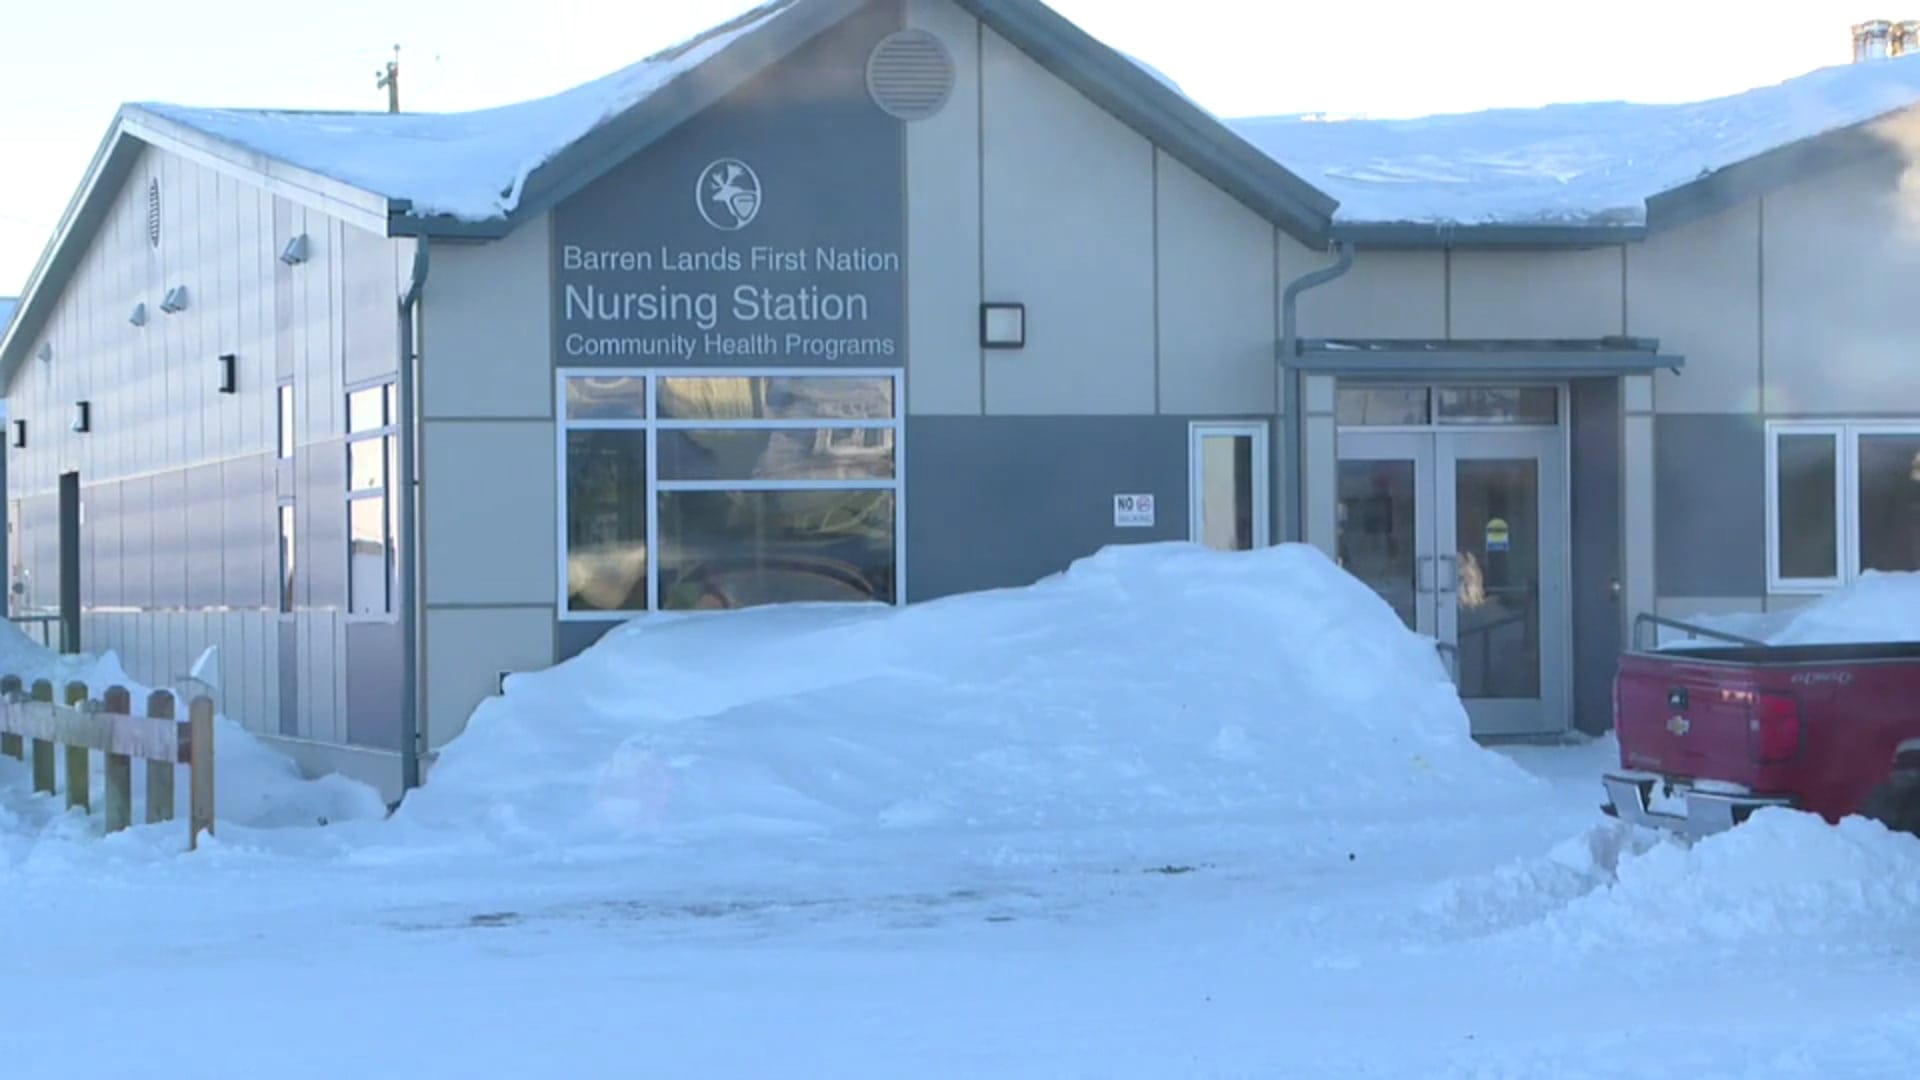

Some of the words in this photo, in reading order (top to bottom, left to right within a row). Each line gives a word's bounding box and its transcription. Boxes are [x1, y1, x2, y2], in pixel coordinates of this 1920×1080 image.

[564, 246, 654, 270] Barren
[661, 247, 742, 270] Lands
[750, 246, 806, 270] First
[816, 247, 899, 270] Nation
[565, 284, 718, 330] Nursing
[733, 285, 868, 320] Station
[566, 335, 697, 360] Community
[703, 335, 777, 355] Health
[785, 335, 896, 359] Programs
